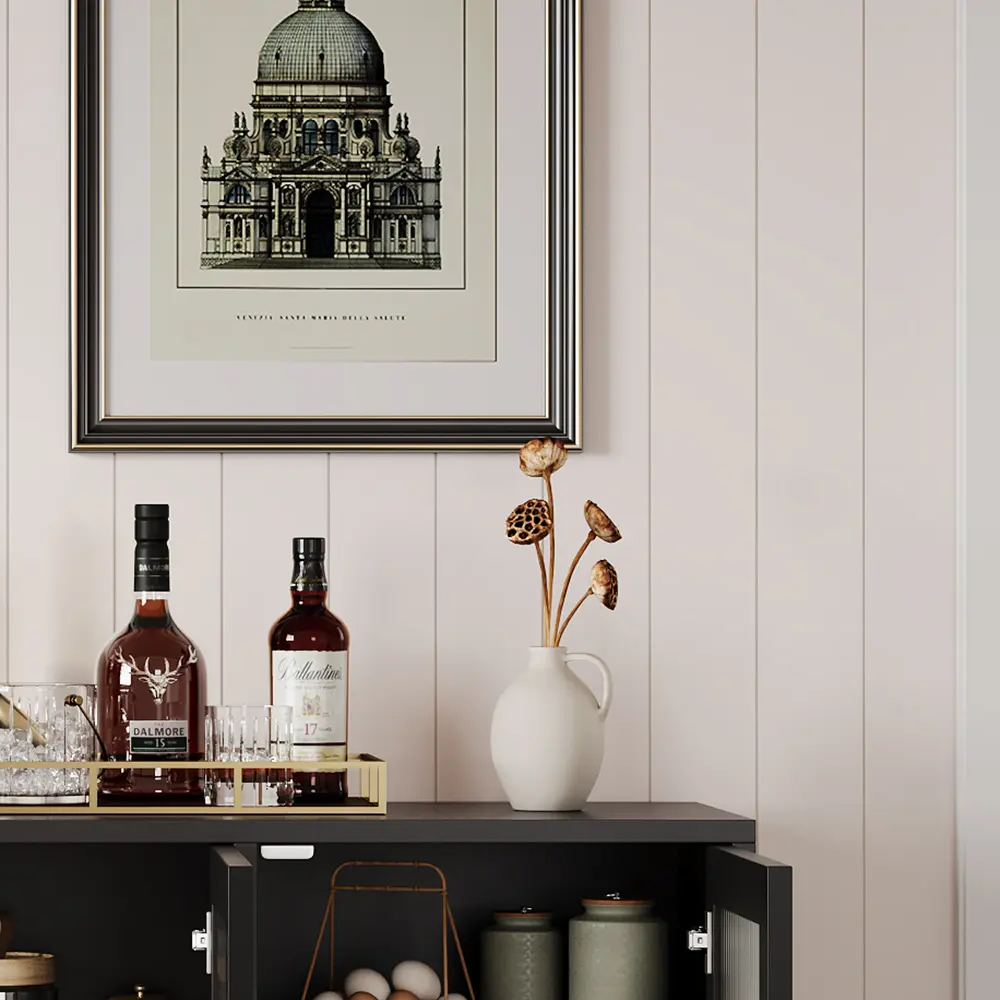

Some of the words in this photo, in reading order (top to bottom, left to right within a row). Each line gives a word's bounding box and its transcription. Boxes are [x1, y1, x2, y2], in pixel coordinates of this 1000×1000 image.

[133, 727, 185, 737] DALMORE
[304, 722, 318, 736] 17
[155, 738, 166, 748] 15
